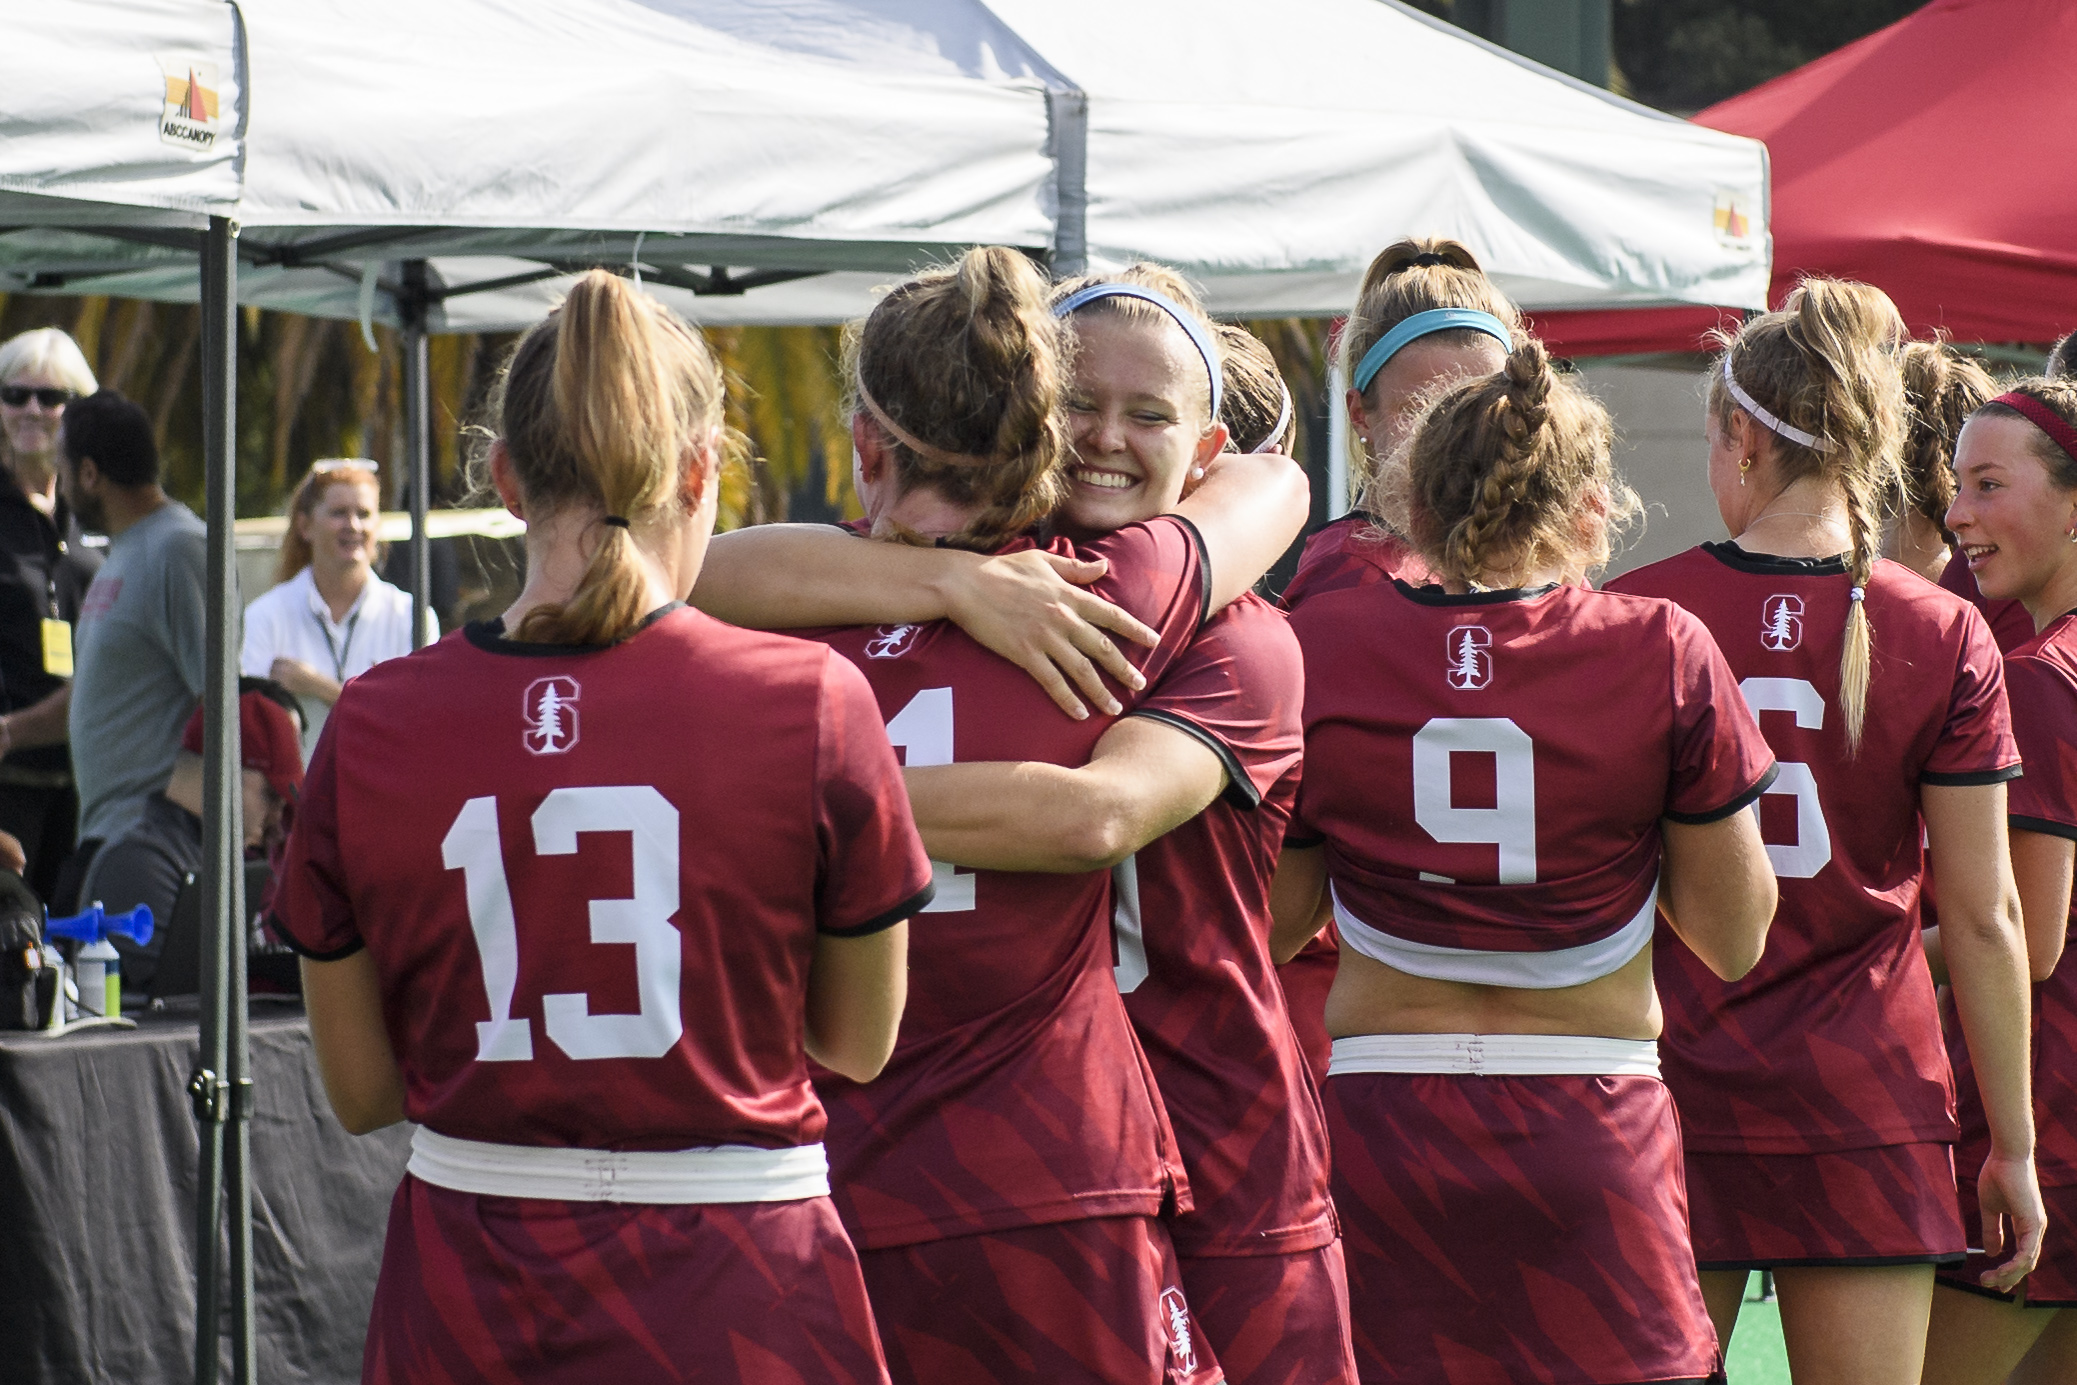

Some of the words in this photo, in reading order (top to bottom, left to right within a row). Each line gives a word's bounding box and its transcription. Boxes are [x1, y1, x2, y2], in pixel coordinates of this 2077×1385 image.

[163, 122, 216, 146] ABCCANOPY
[1413, 717, 1537, 885] 9
[1738, 677, 1831, 878] 6
[441, 785, 683, 1062] 13
